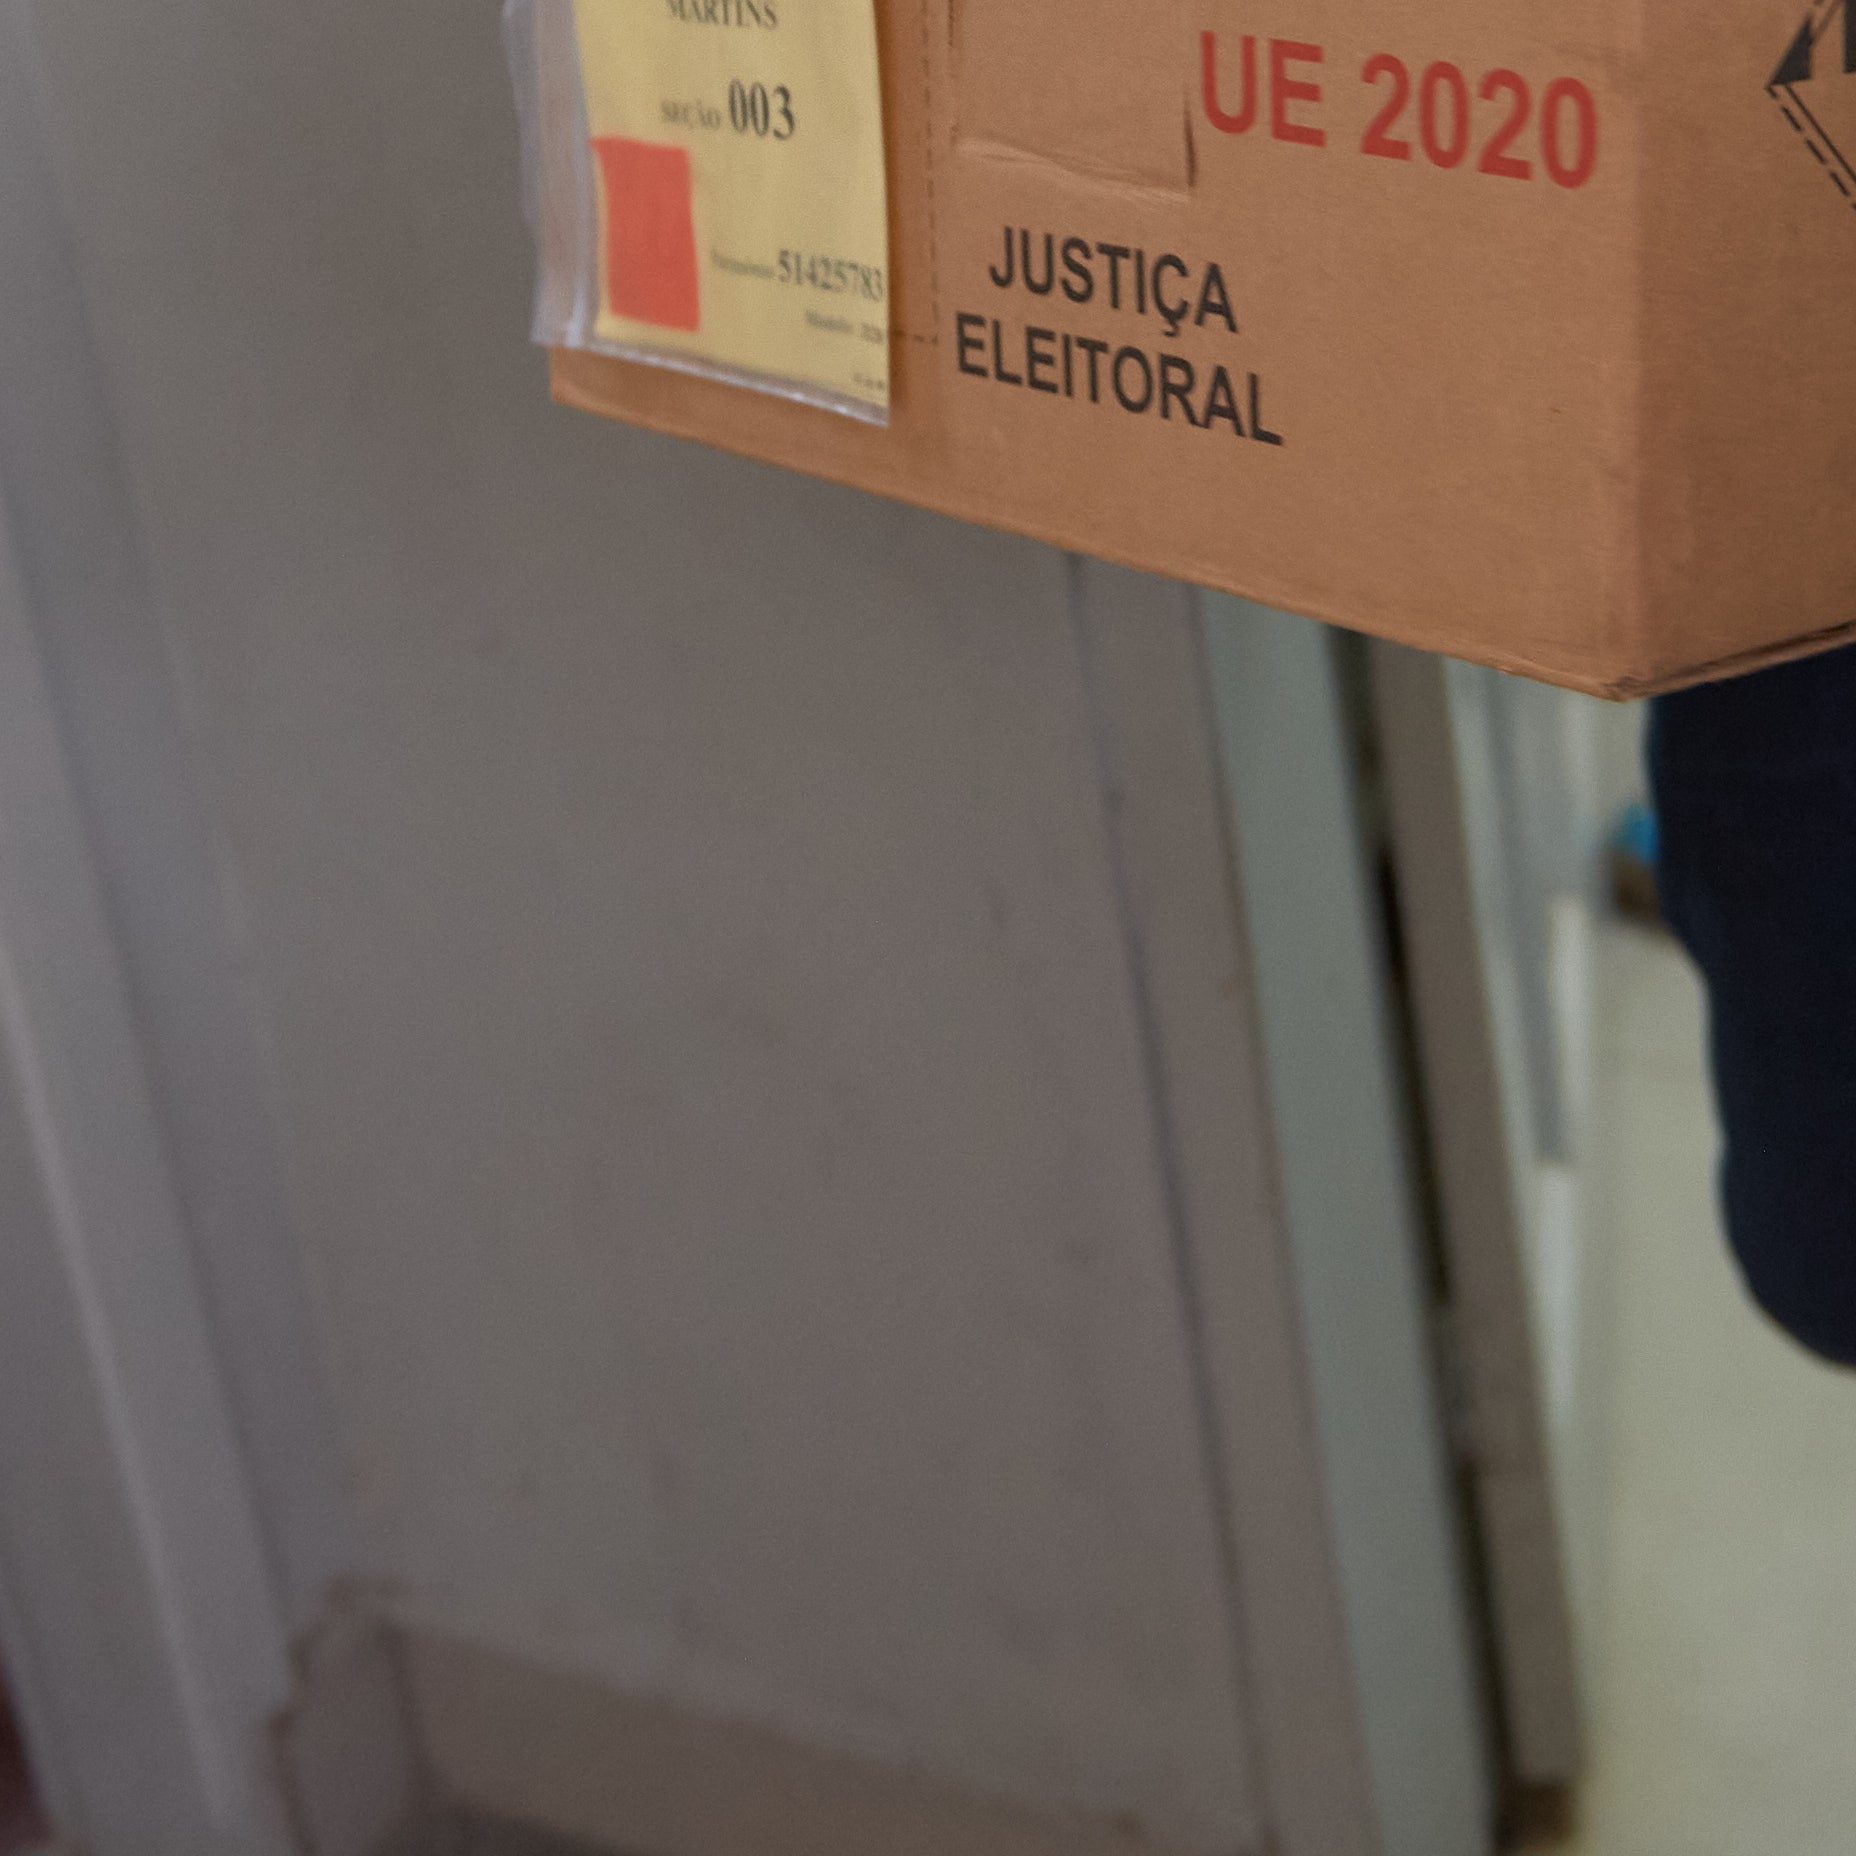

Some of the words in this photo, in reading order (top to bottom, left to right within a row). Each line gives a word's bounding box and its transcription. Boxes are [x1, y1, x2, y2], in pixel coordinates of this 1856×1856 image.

[728, 78, 796, 141] 003
[1200, 29, 1328, 149] UE
[1359, 52, 1599, 190] 2020
[989, 226, 1239, 337] JUSTIÇA
[956, 311, 1285, 446] ELEITORAL
